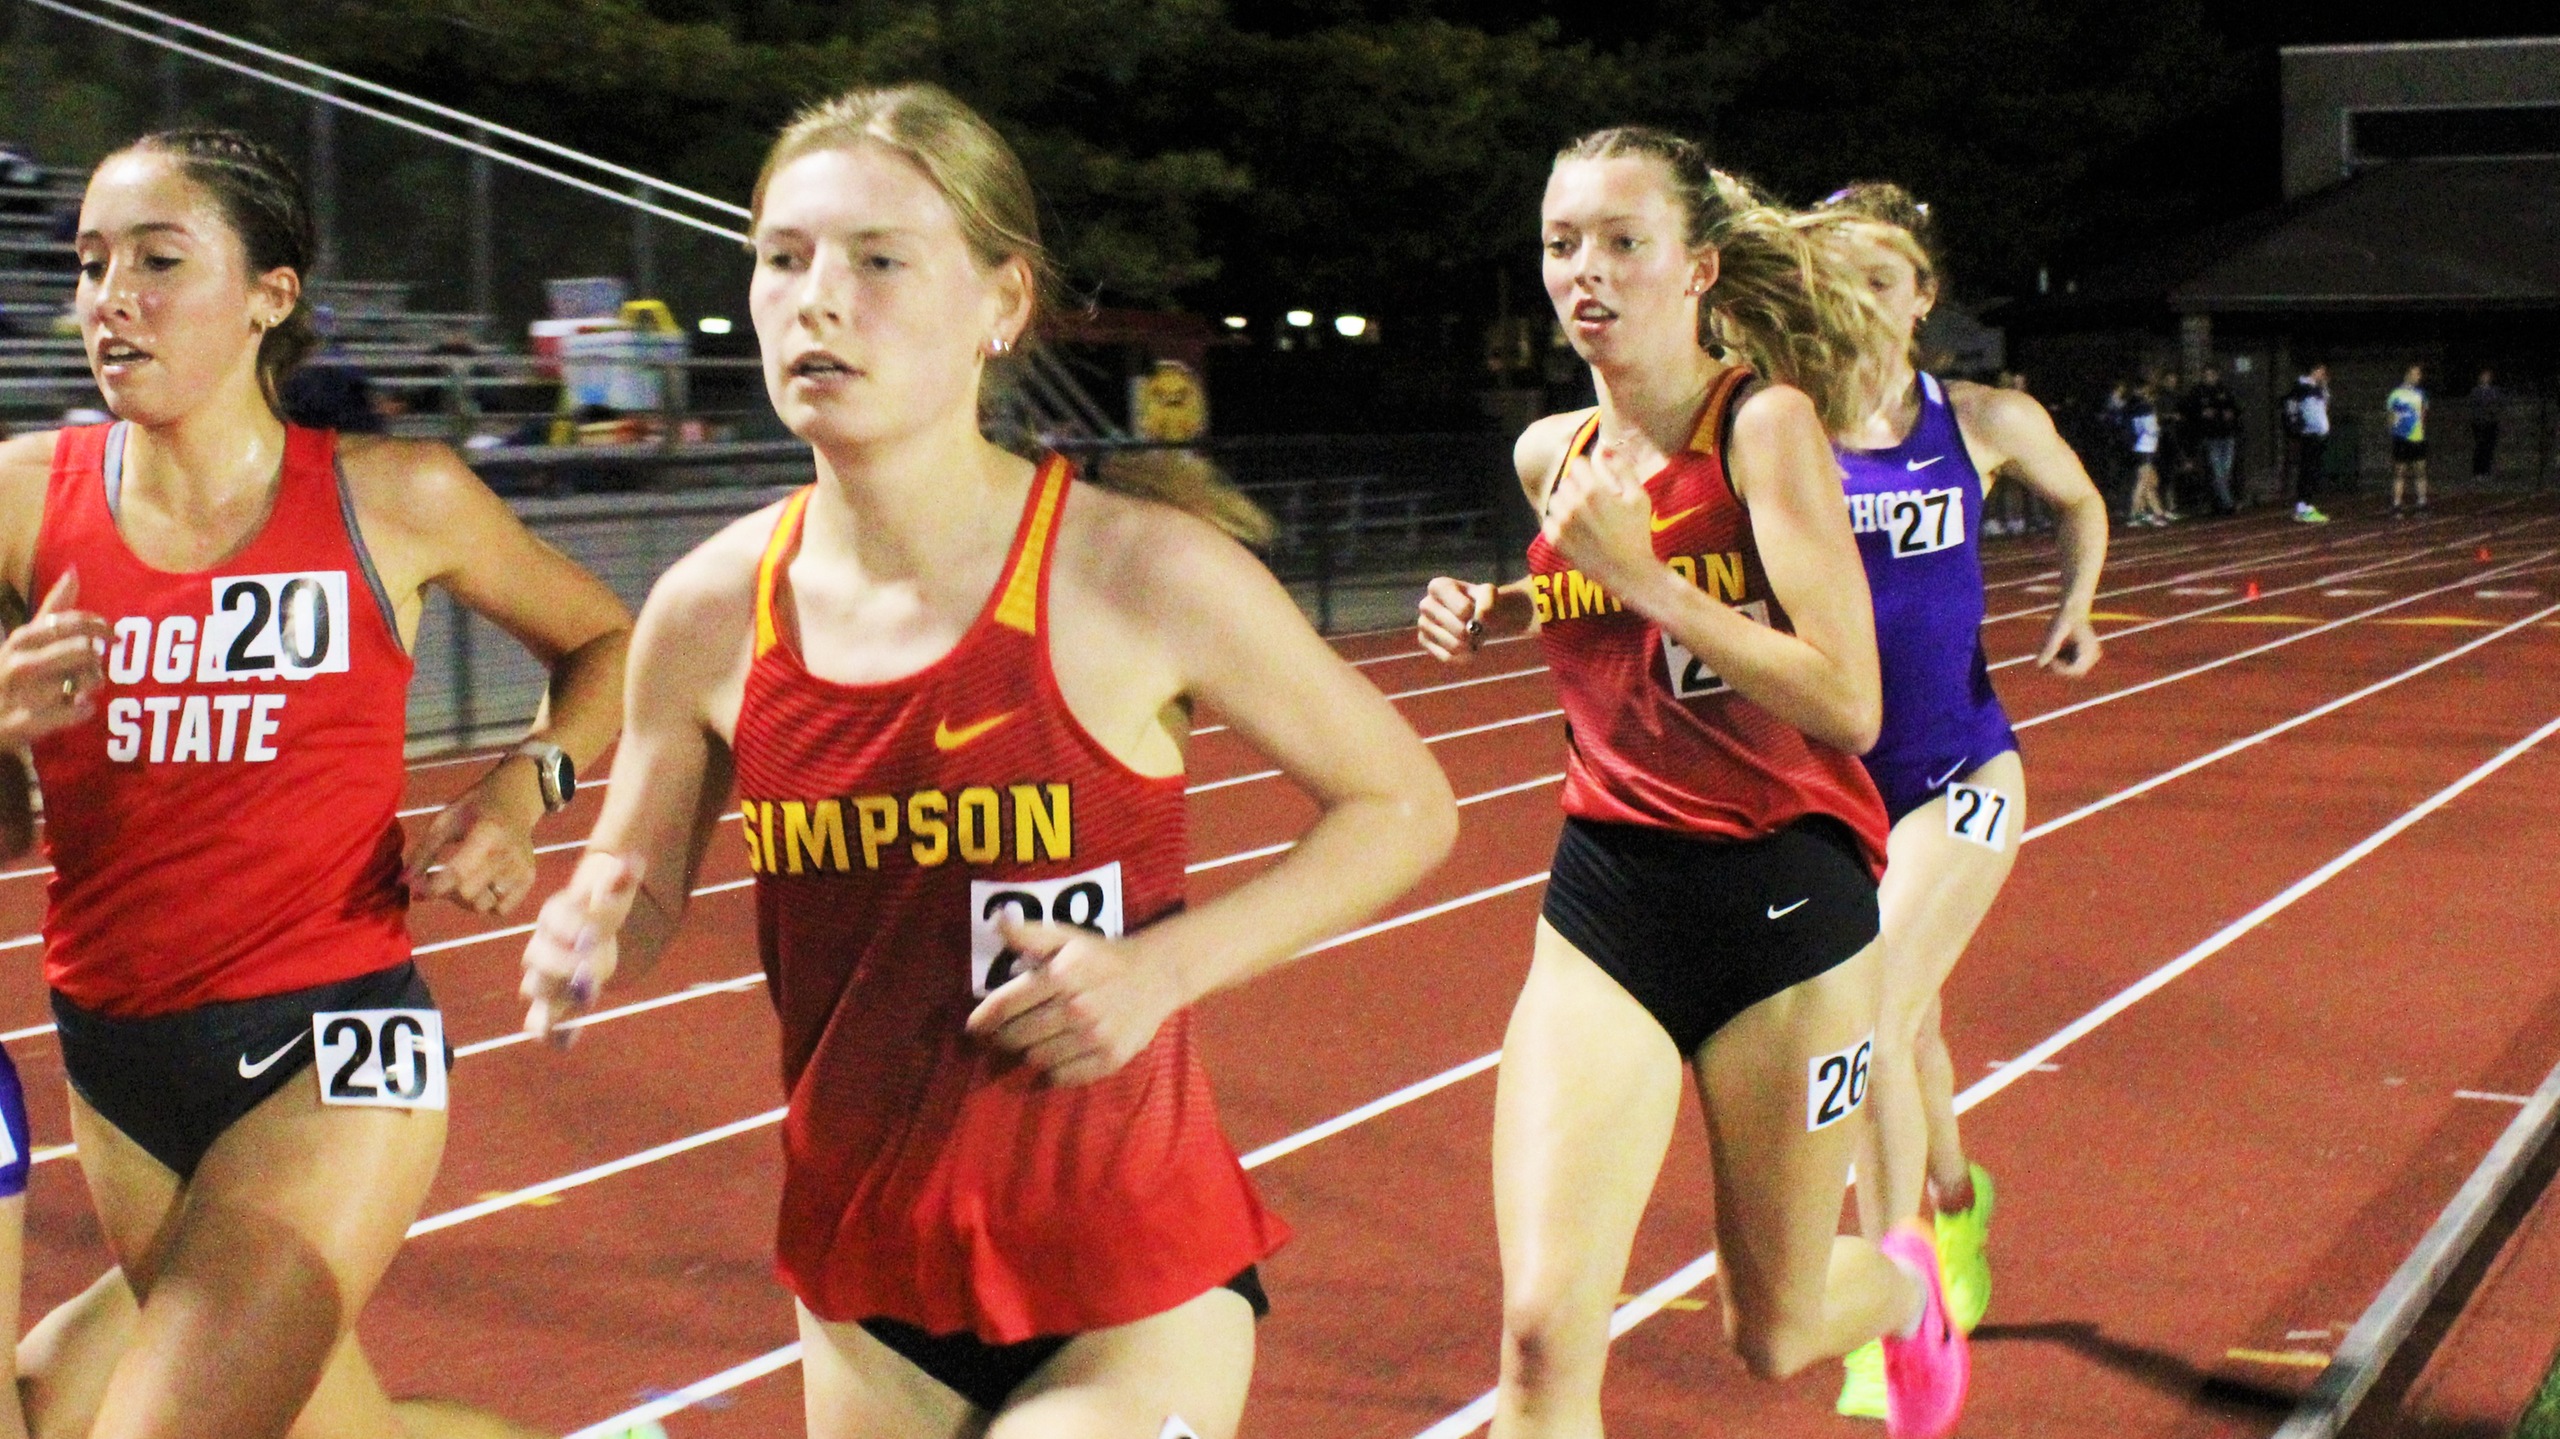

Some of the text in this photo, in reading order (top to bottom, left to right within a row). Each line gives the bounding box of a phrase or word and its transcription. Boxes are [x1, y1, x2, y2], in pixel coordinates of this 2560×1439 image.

[1893, 493, 1950, 554] 27
[221, 577, 331, 672] 20
[106, 694, 287, 764] STATE
[740, 783, 1073, 876] SIMPSON
[1954, 788, 2006, 842] 27
[322, 1014, 429, 1101] 20
[1816, 1040, 1870, 1126] 26
